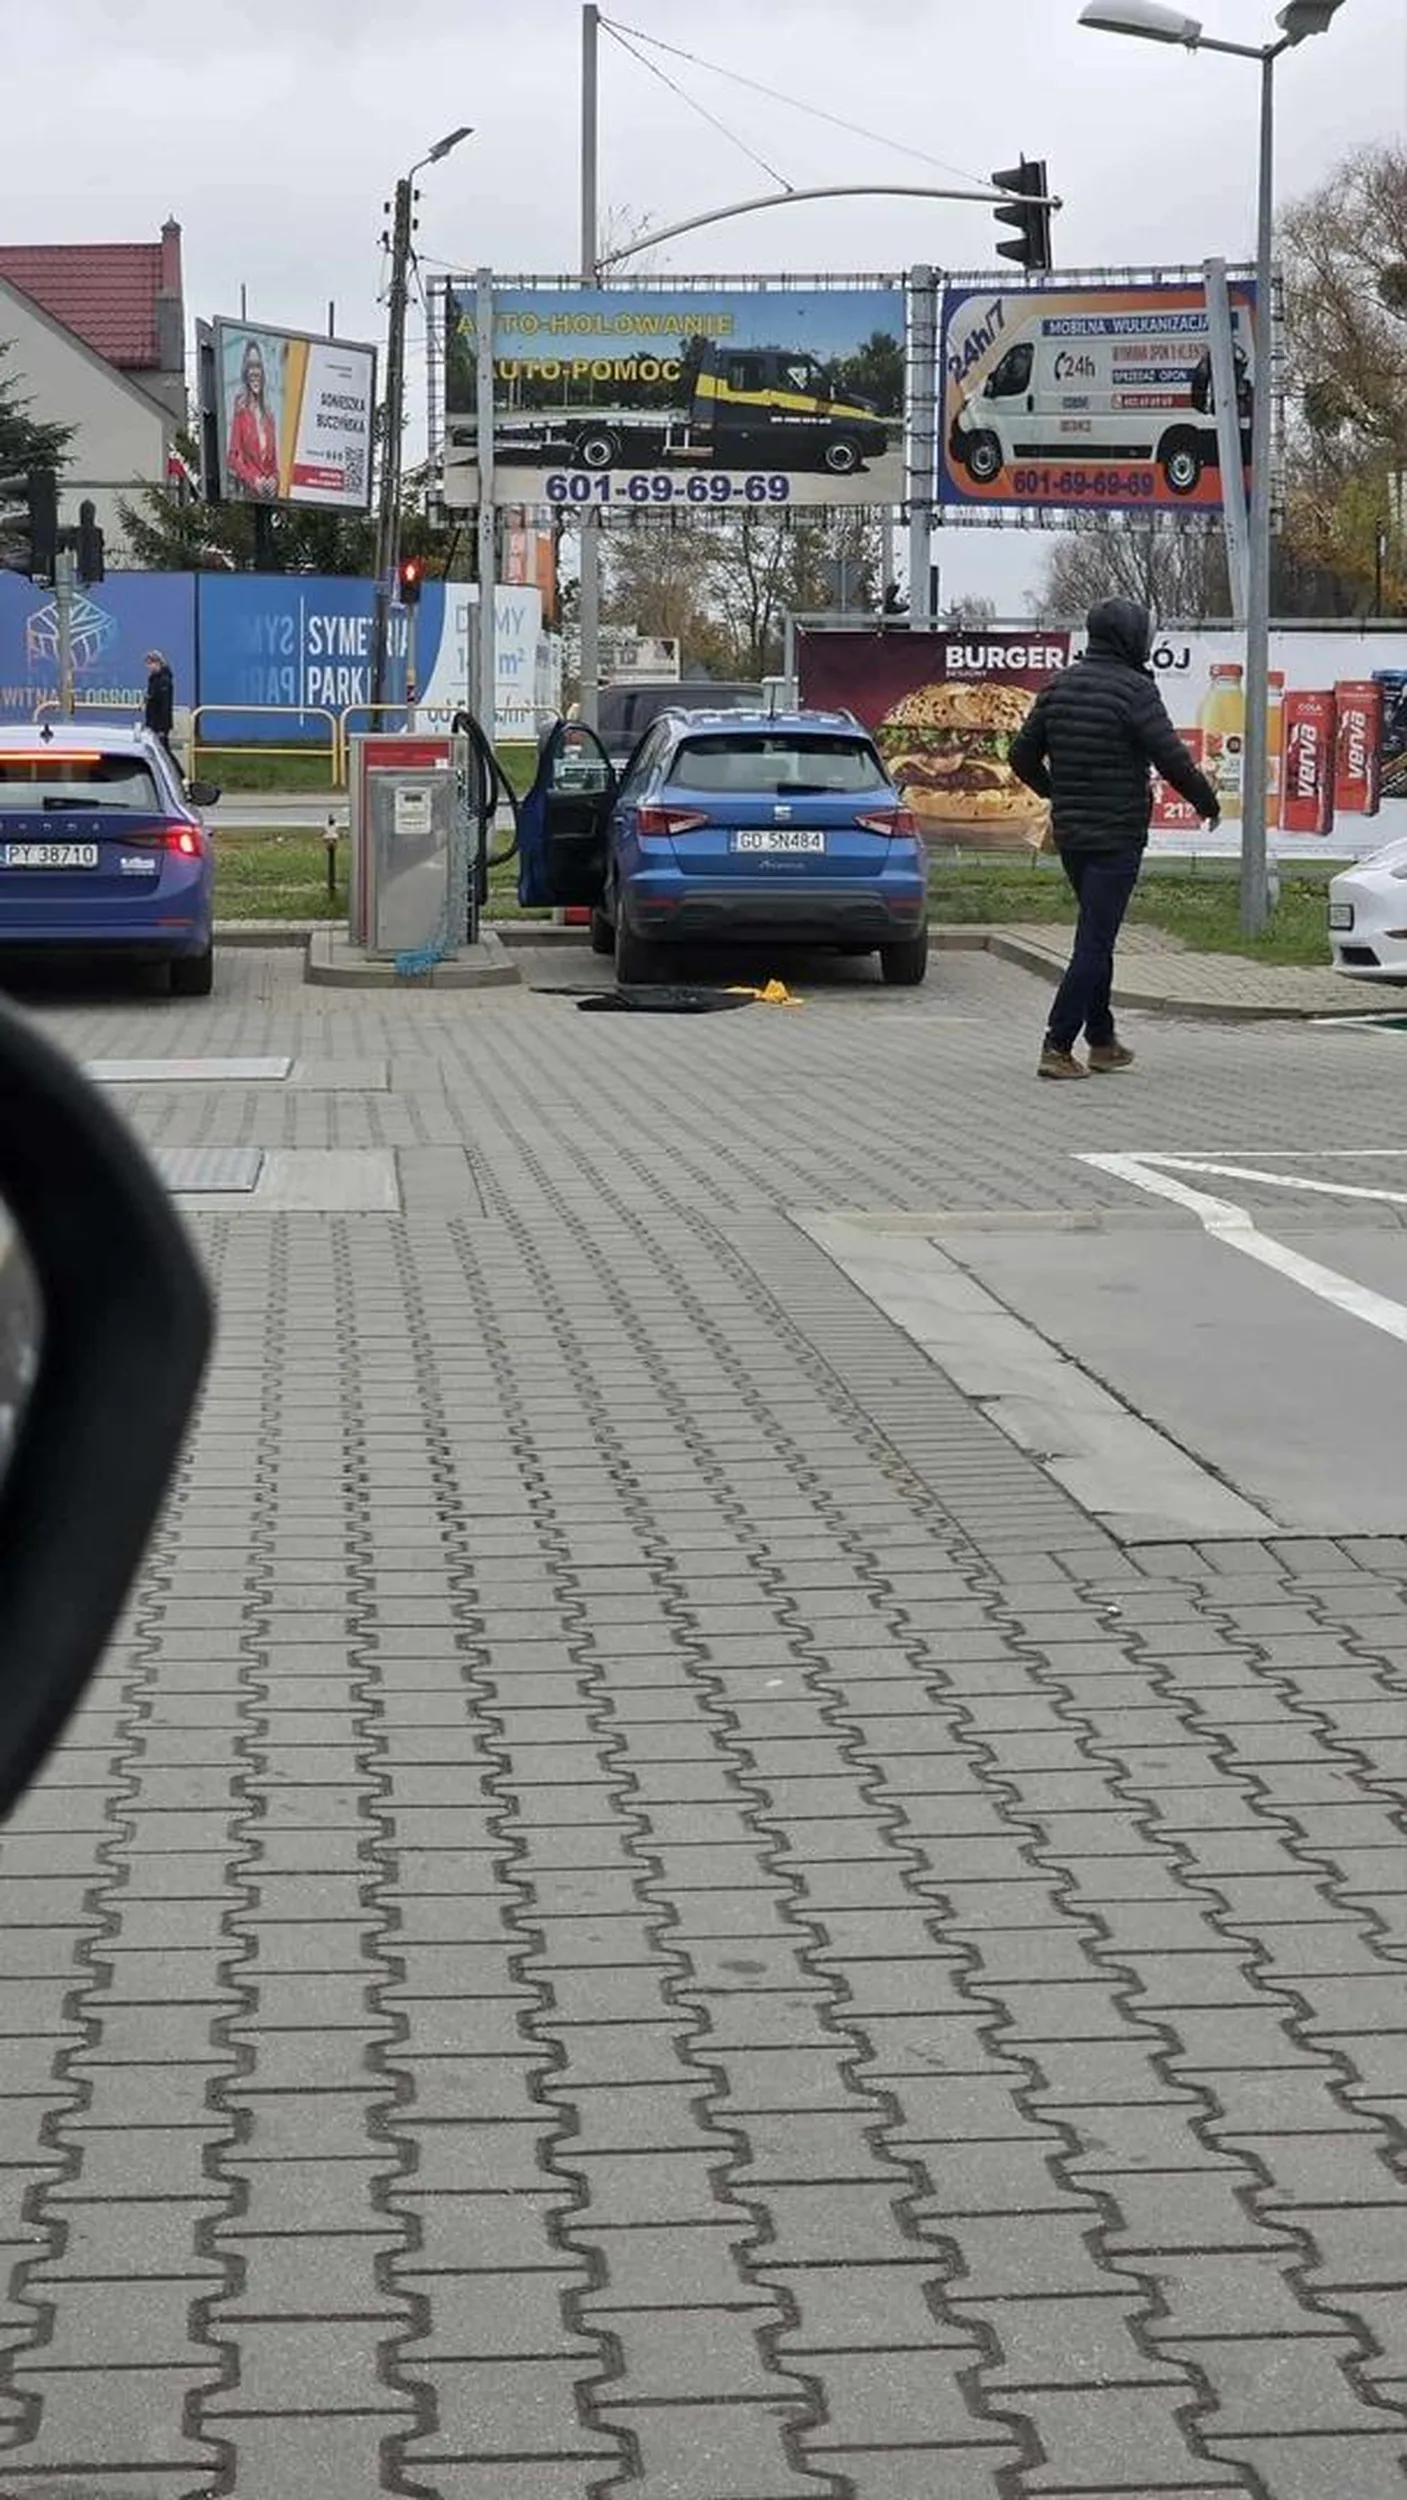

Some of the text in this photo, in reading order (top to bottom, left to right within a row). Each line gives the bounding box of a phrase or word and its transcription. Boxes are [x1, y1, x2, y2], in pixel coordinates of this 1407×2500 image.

[456, 312, 735, 336] ATO-HOLOWANIE
[1050, 319, 1106, 335] MOBILNA
[949, 299, 1005, 384] 24h/7
[1063, 353, 1096, 379] 24h
[545, 474, 790, 502] 601-69-69-69
[1014, 470, 1155, 496] 601-69-69-69
[945, 645, 1051, 670] BURGER
[1349, 711, 1367, 779] verva
[1298, 724, 1318, 797] verva
[8, 846, 94, 862] PY 38710
[741, 833, 820, 849] GD 5N484
